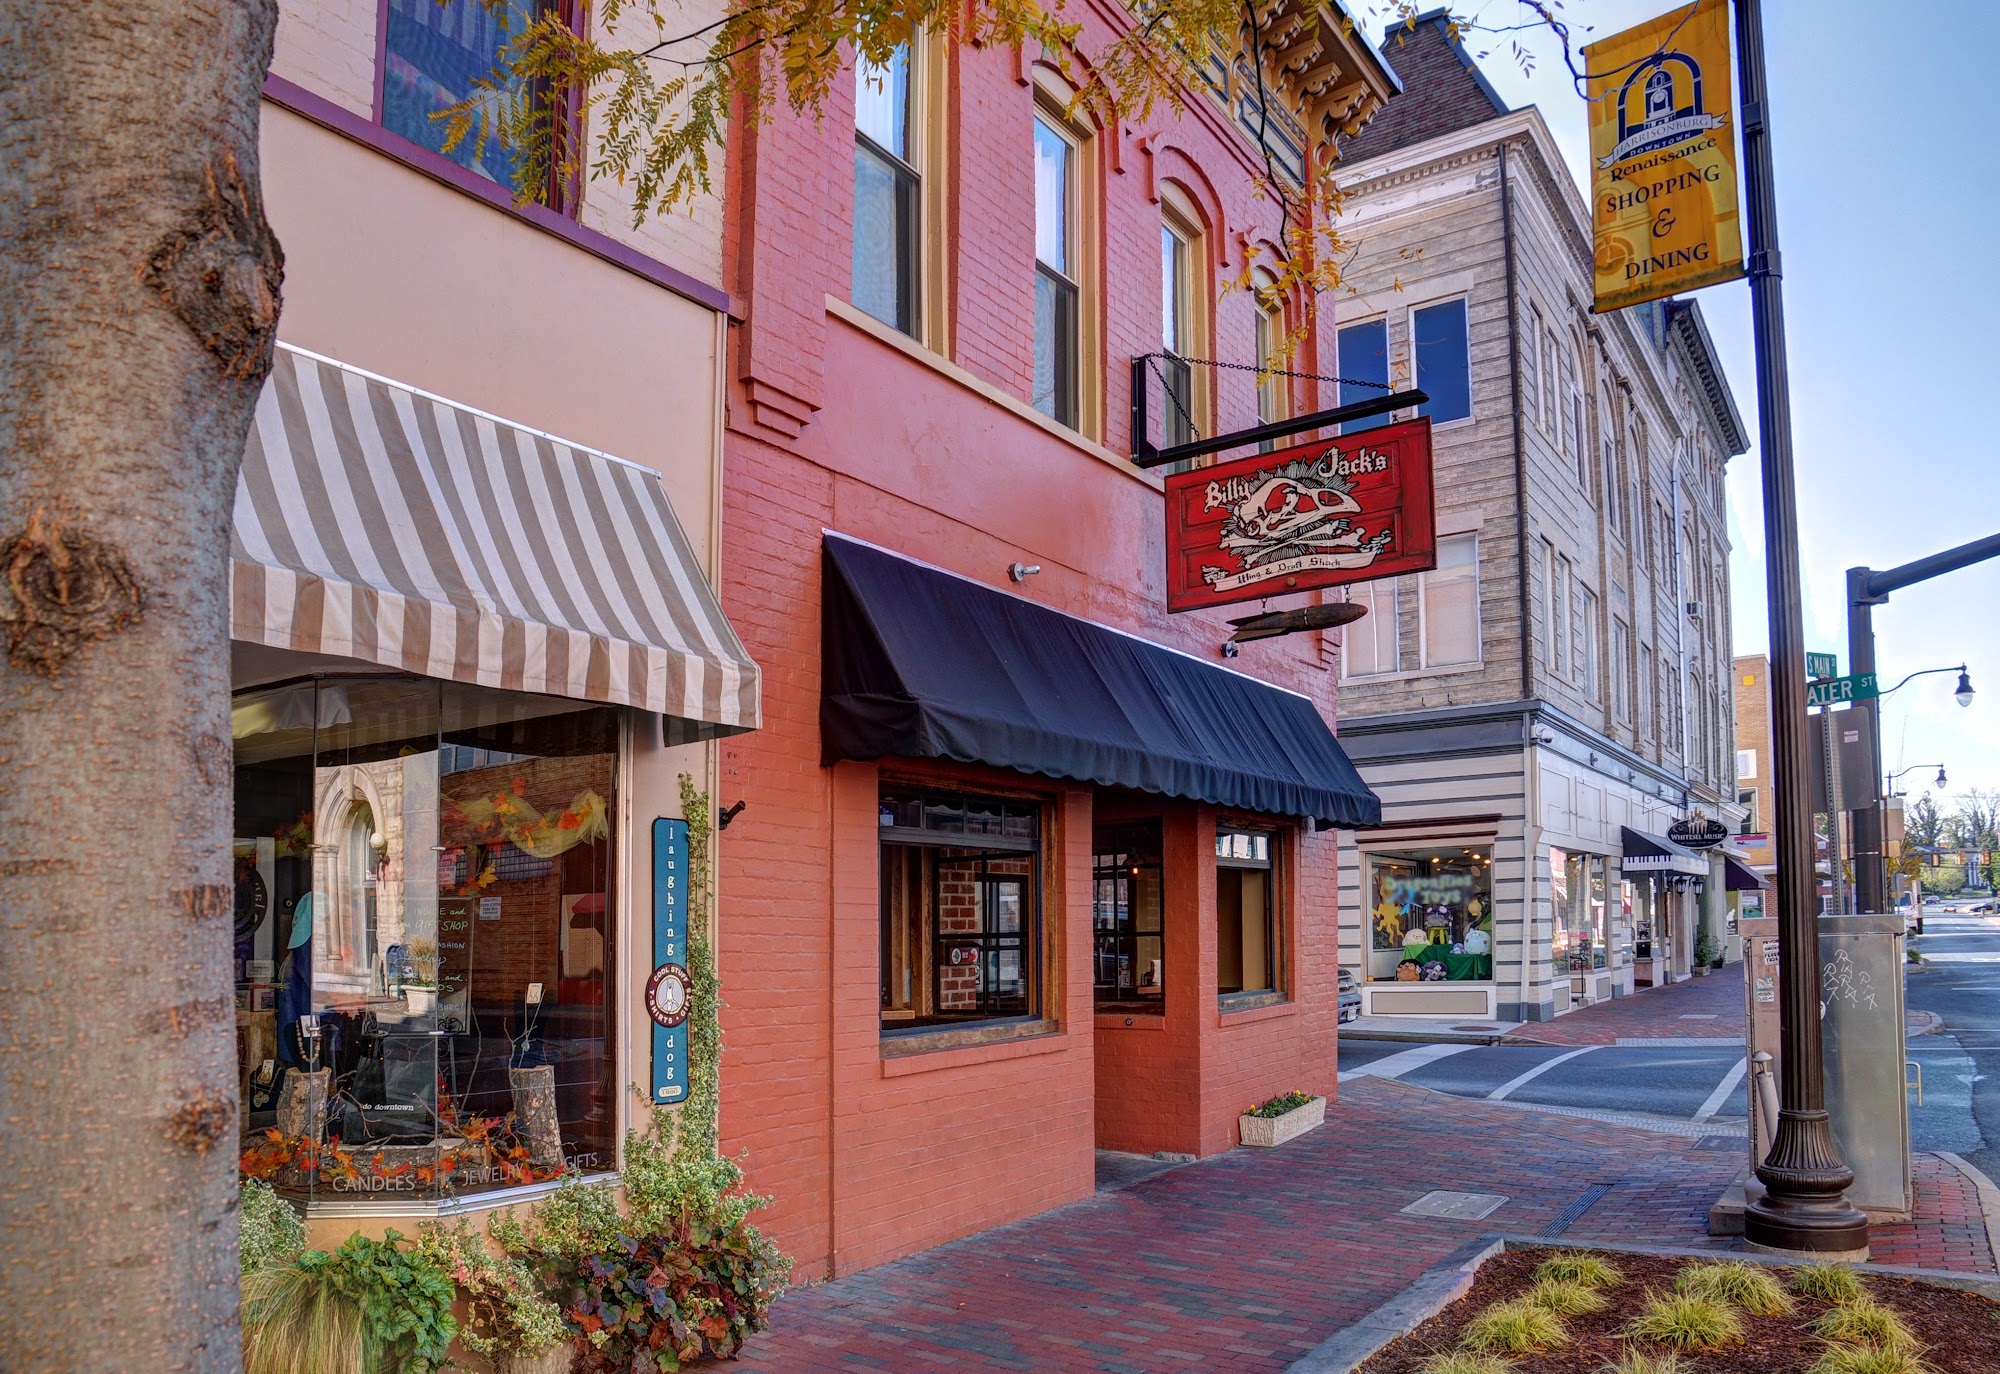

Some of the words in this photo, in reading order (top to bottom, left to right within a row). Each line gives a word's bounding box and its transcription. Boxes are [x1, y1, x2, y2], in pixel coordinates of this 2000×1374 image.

[1616, 117, 1708, 156] HARRISONBURG
[1630, 132, 1691, 157] DOWNTOWN
[1610, 137, 1717, 182] Renaissance
[1606, 164, 1720, 214] SHOPPING
[1652, 208, 1676, 238] &
[1624, 242, 1710, 280] DINING
[1204, 480, 1251, 514] Billy
[1318, 446, 1388, 478] Jack's
[1237, 572, 1261, 585] Wing
[1265, 567, 1273, 576] &
[1277, 561, 1303, 573] Draft
[1308, 557, 1341, 567] Shack
[1808, 655, 1813, 673] S
[1814, 655, 1830, 674] MAIN
[1807, 680, 1853, 705] ATER
[1861, 676, 1873, 687] ST
[667, 827, 676, 956] laughing
[450, 907, 467, 915] and
[441, 921, 468, 931] SHOP
[653, 966, 670, 982] COOL
[670, 966, 690, 982] STUFF
[649, 989, 673, 1025] T-SHIRTS
[667, 1034, 675, 1080] dog
[362, 1102, 372, 1110] do
[374, 1103, 414, 1112] downtown
[462, 1163, 524, 1187] JEWELRY
[564, 1152, 599, 1173] GIFTS
[332, 1174, 416, 1193] CANDLES
